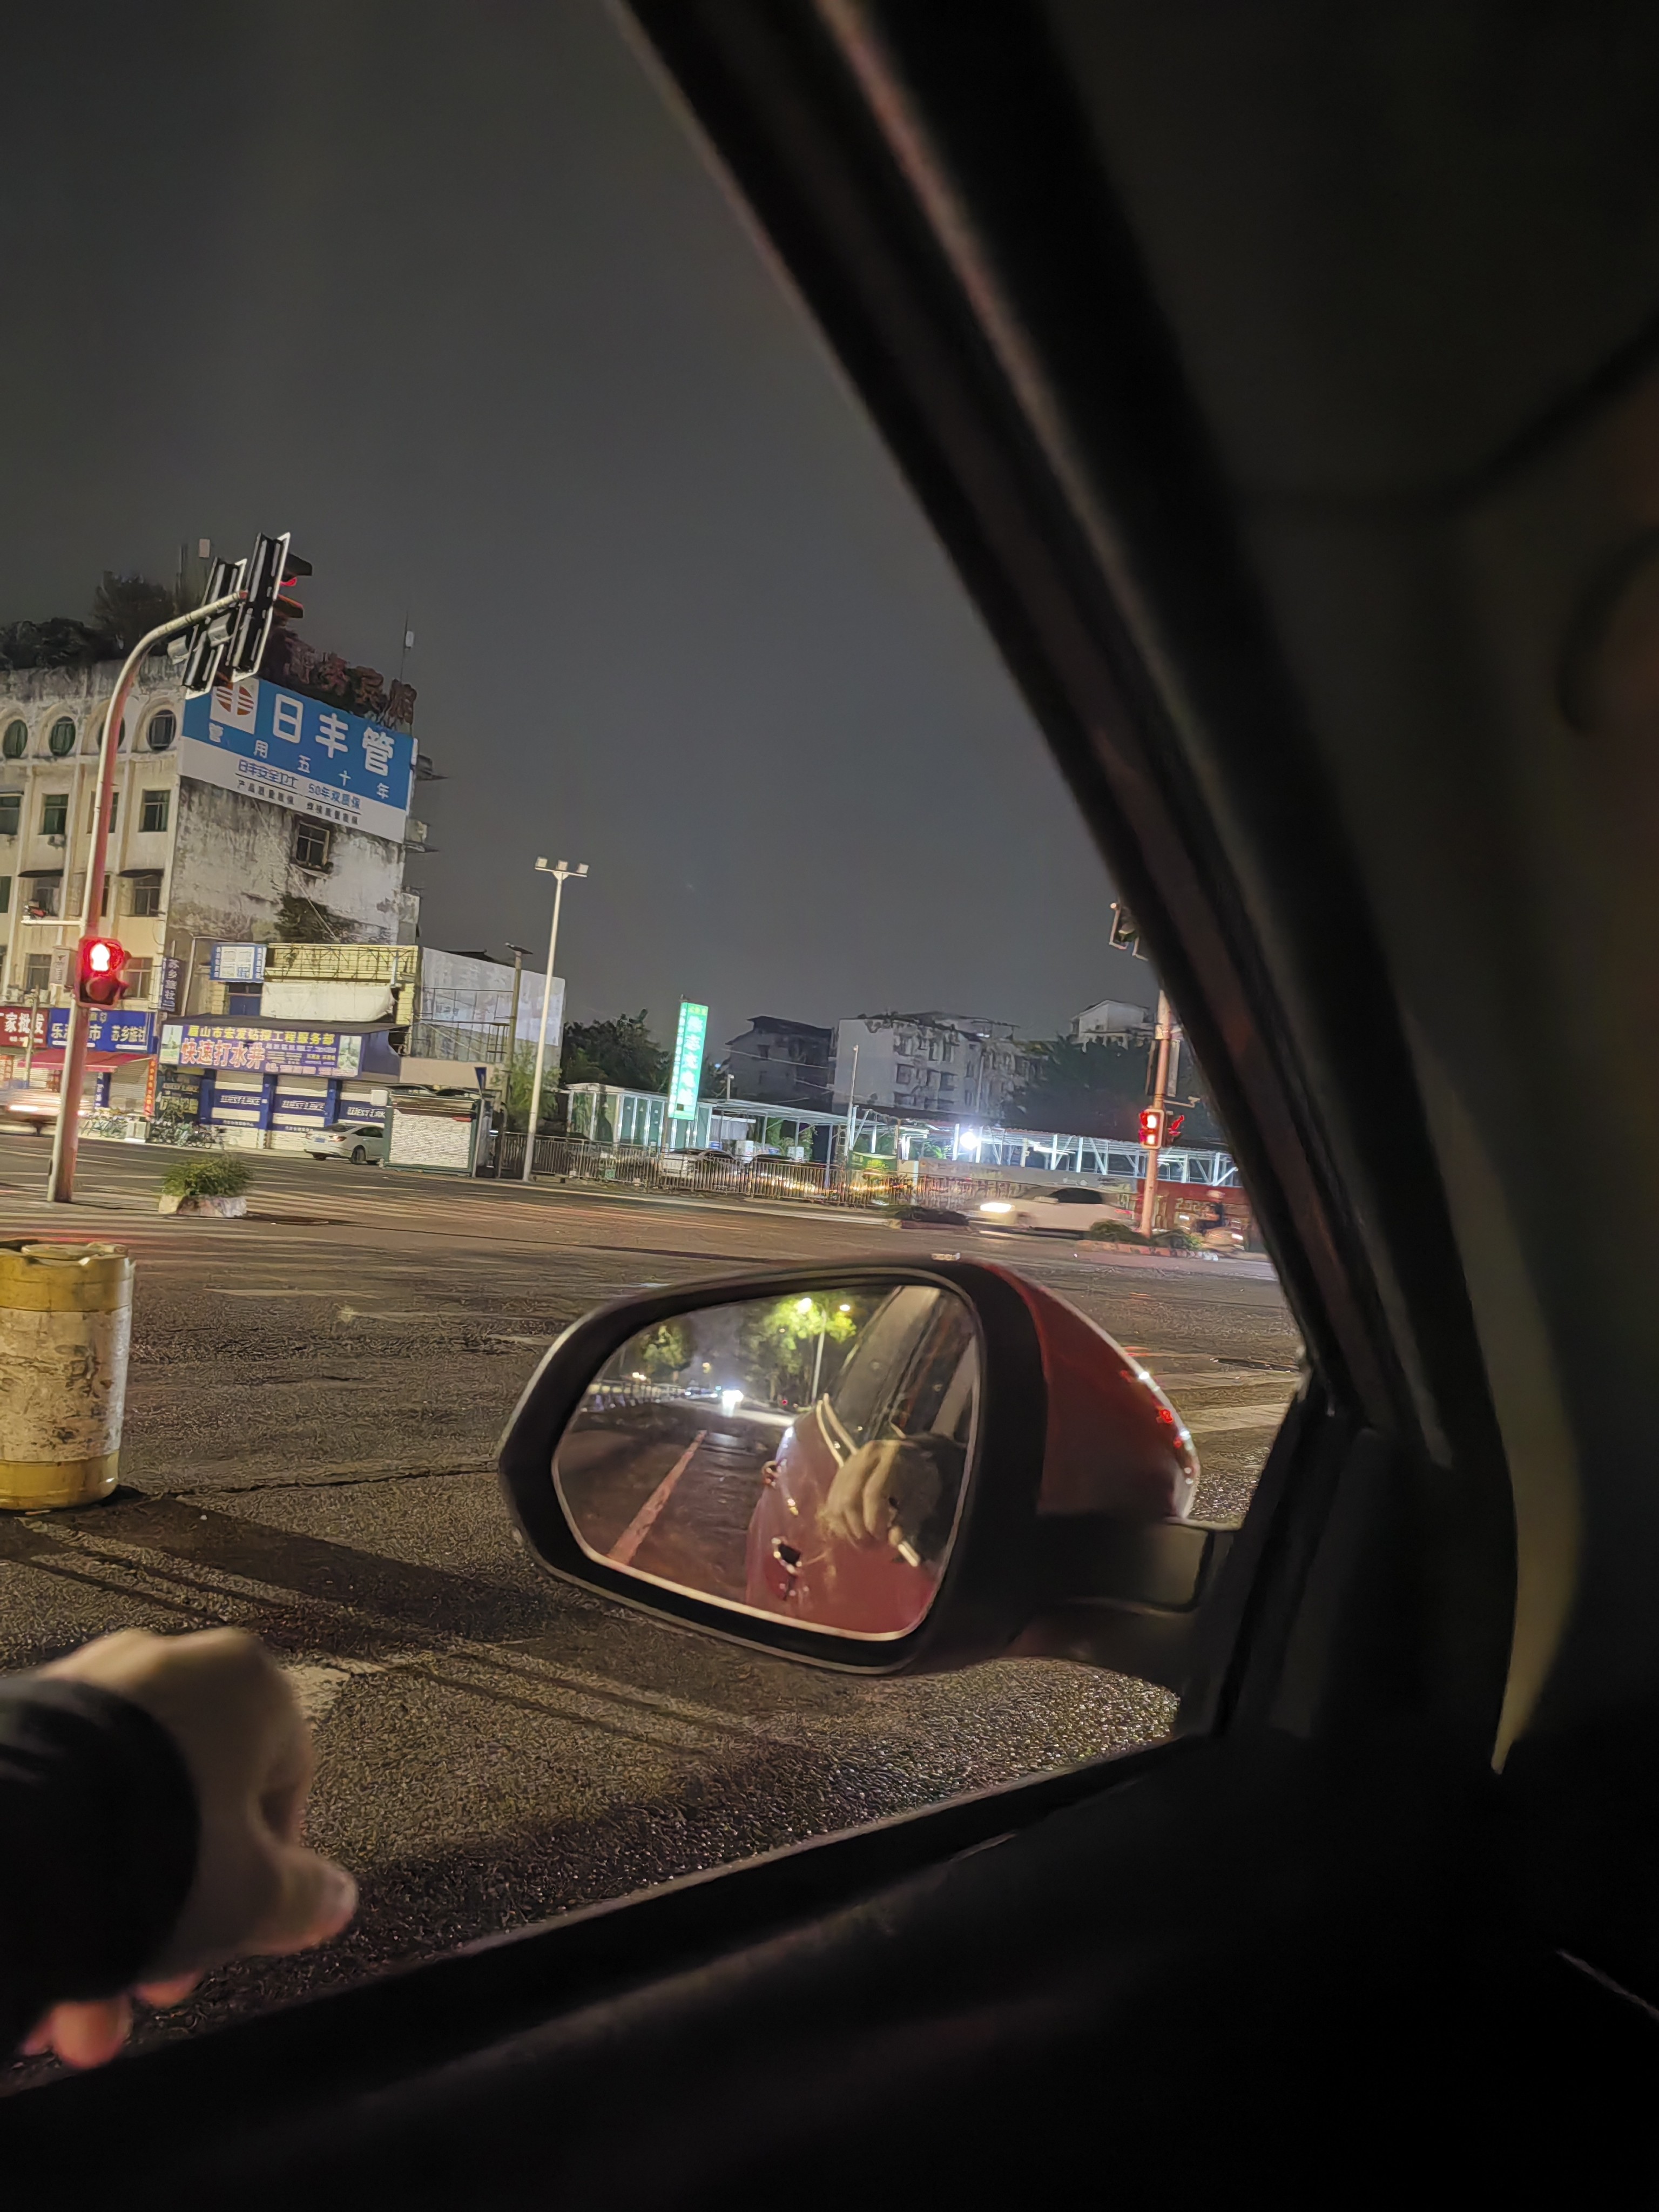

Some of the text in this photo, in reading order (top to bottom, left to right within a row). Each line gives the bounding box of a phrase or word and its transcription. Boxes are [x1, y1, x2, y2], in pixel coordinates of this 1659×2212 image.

[273, 693, 396, 776] 日丰管
[181, 1037, 266, 1069] 快速打水井
